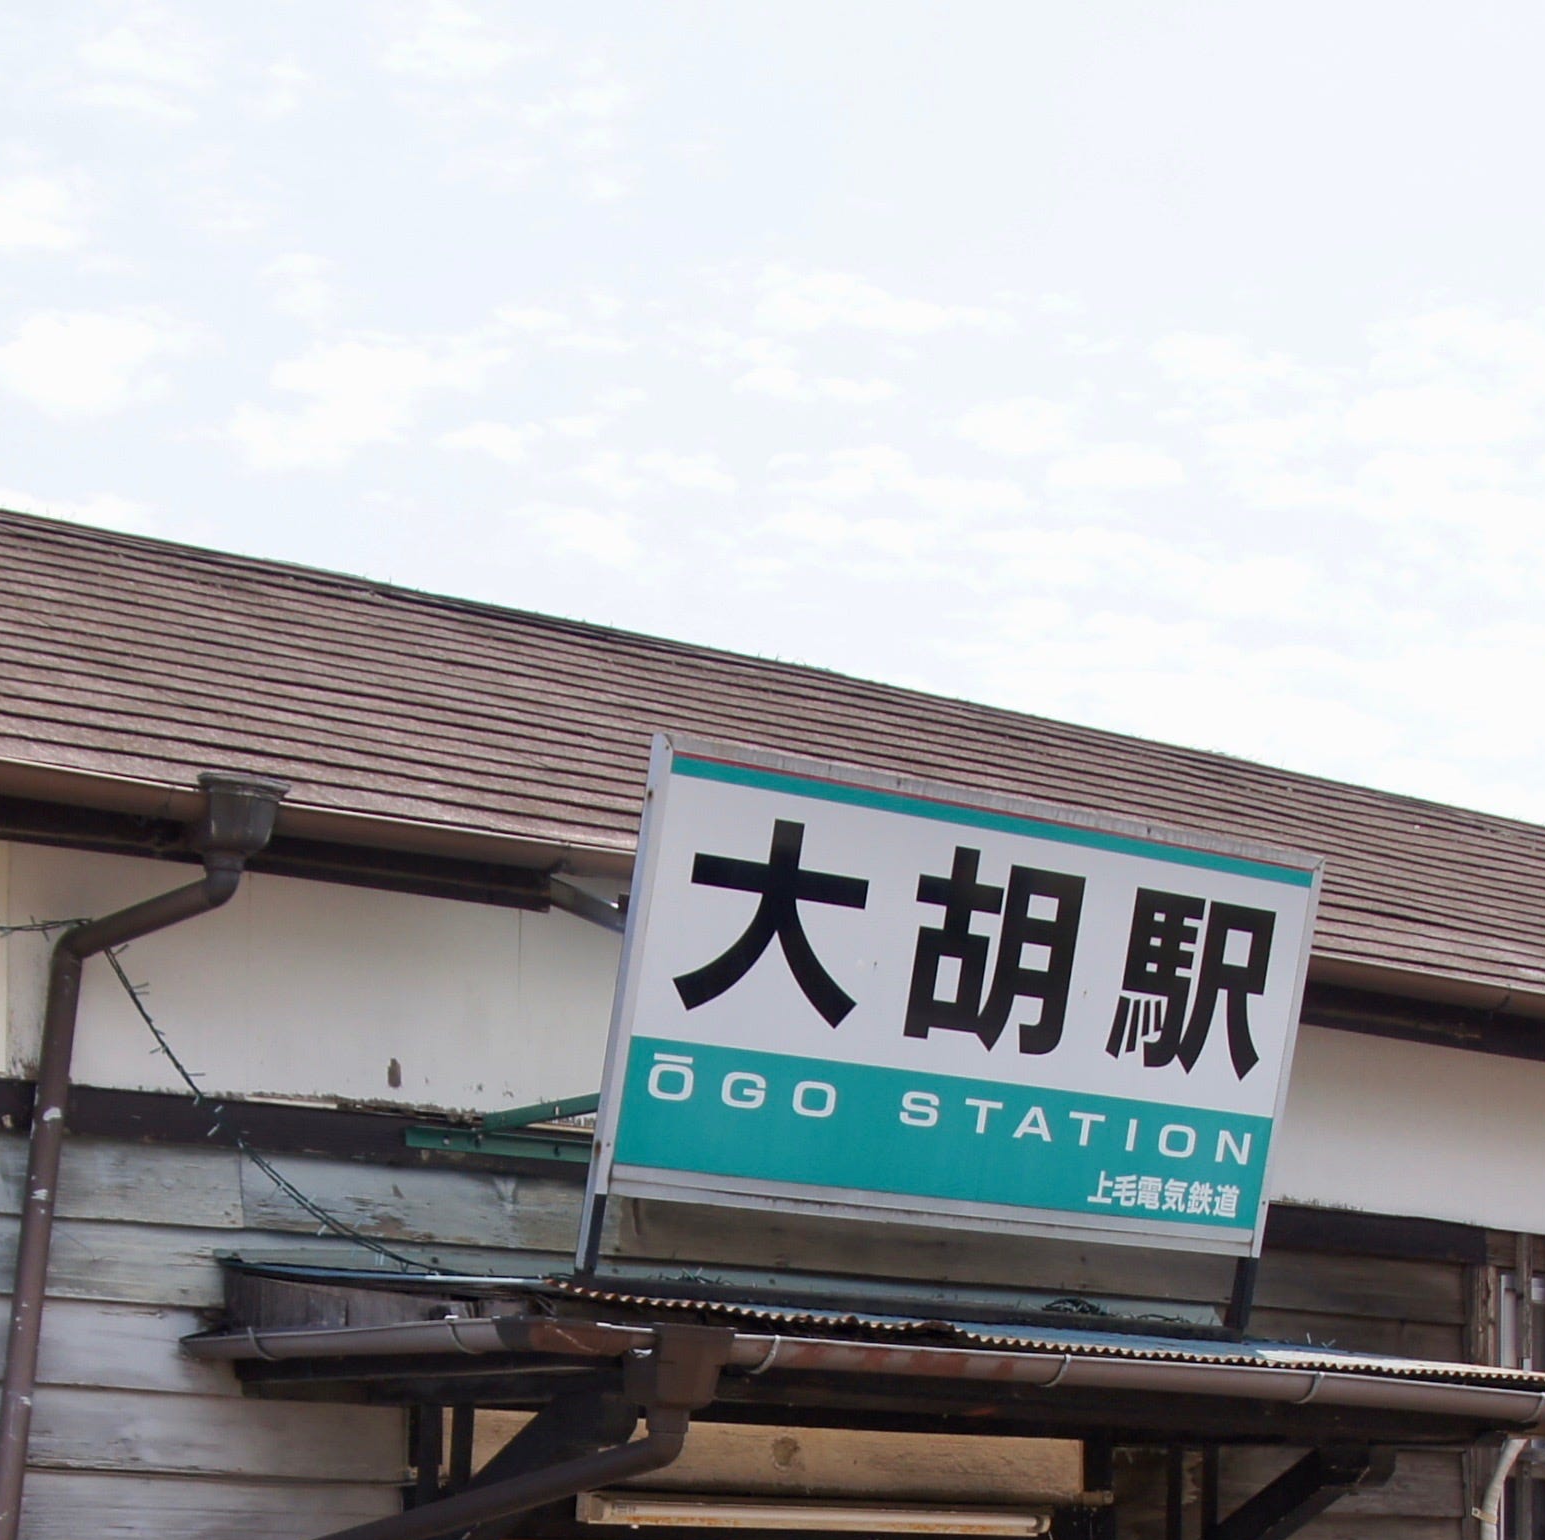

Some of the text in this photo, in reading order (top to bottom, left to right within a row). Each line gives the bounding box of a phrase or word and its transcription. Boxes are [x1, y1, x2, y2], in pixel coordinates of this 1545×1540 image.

[671, 816, 1277, 1082] 大胡駅
[899, 1088, 1253, 1167] STATION
[1086, 1169, 1242, 1221] 上毛電気鉄道
